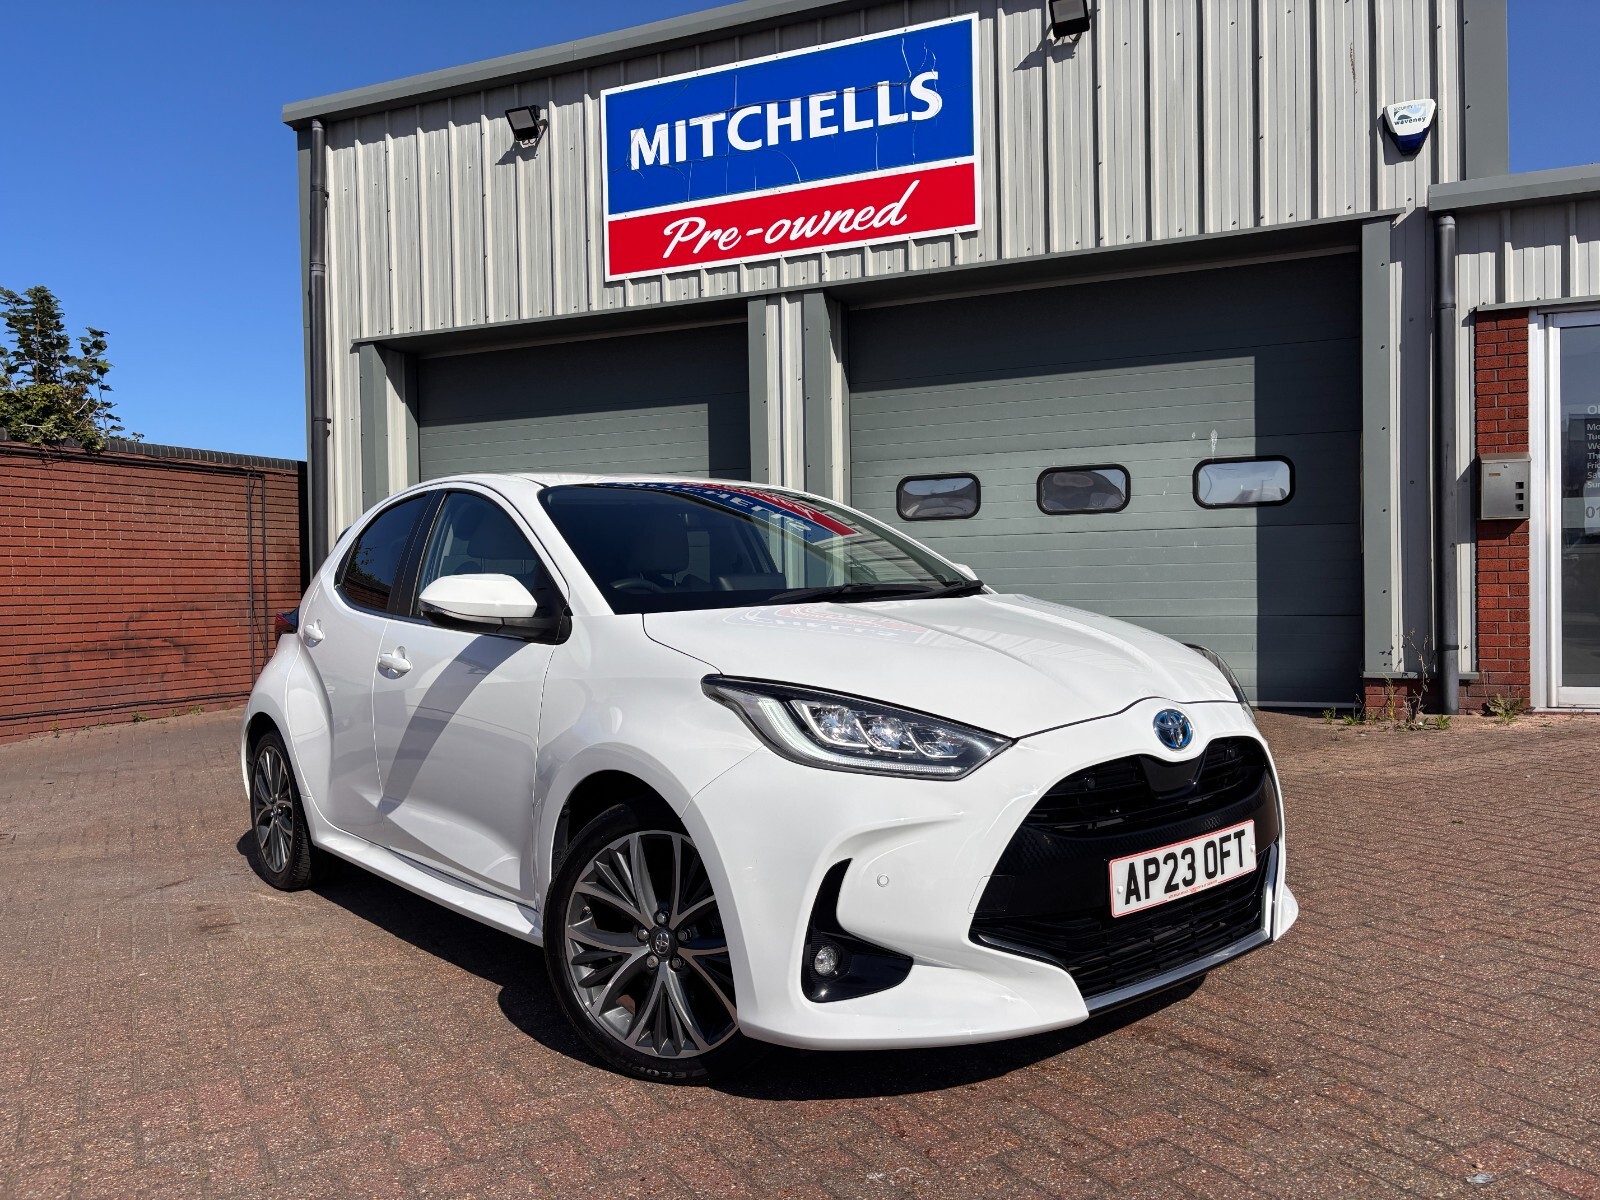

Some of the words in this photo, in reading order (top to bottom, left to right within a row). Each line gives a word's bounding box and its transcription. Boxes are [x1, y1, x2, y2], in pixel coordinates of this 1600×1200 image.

[630, 71, 943, 171] MITCHELLS
[1394, 117, 1426, 125] waveney
[662, 179, 920, 259] Pre-owned
[1124, 846, 1196, 906] AP23
[1203, 829, 1246, 880] OFT
